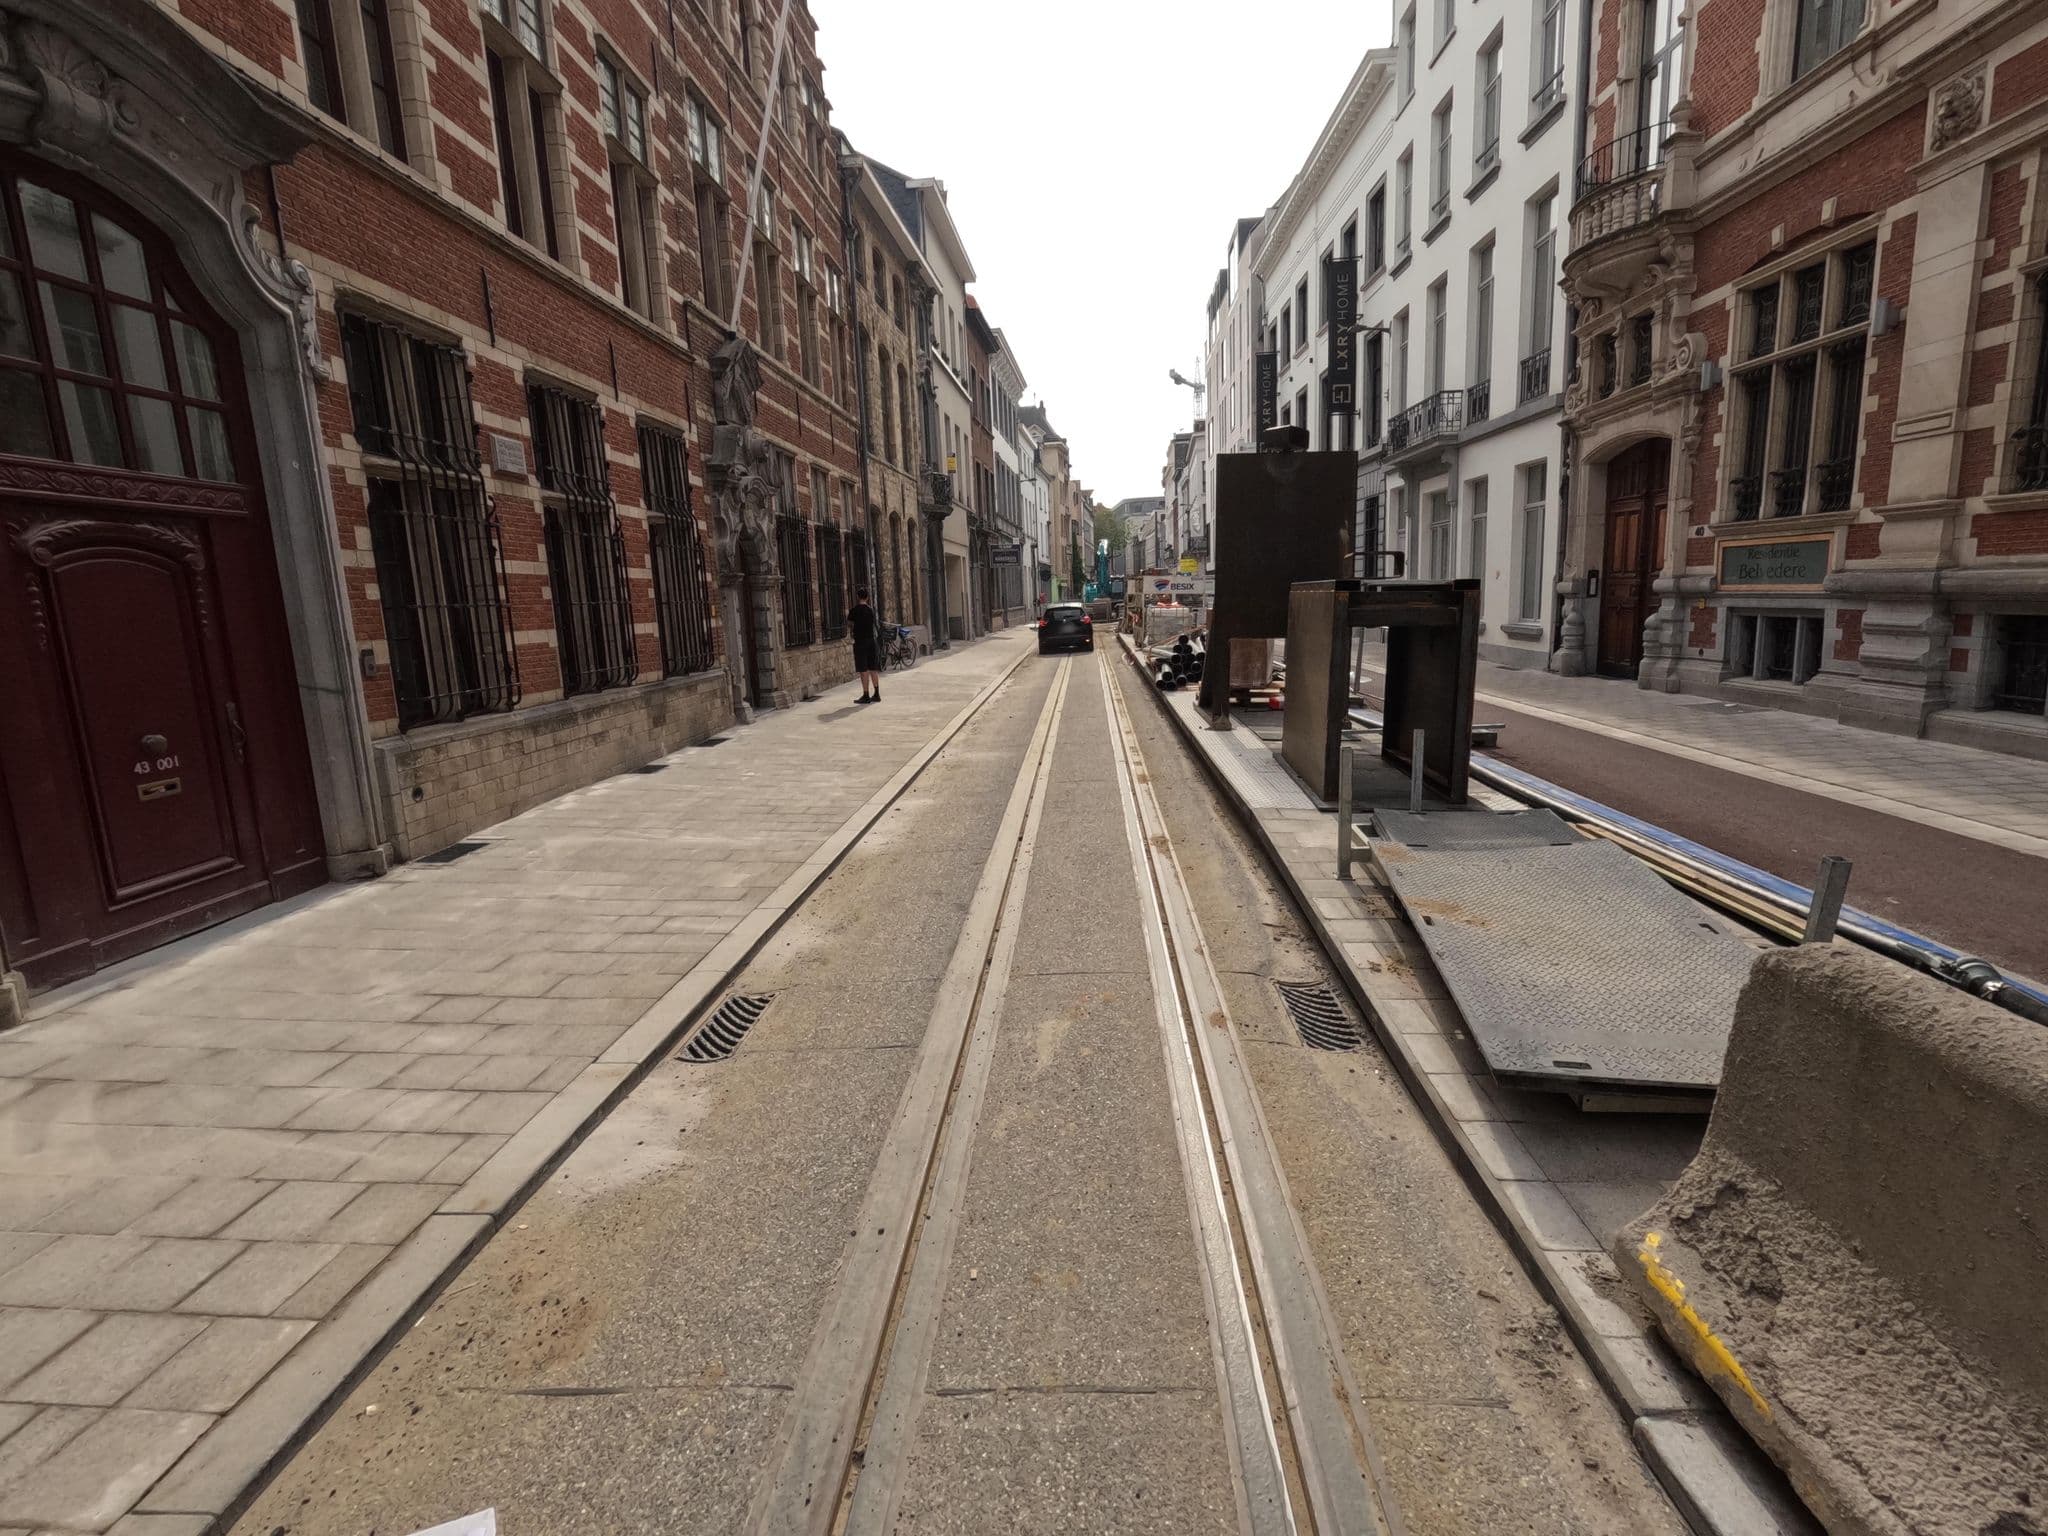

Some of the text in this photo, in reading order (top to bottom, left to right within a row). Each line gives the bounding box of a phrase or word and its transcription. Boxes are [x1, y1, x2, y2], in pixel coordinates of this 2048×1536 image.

[1262, 363, 1271, 427] XRYHOME
[1694, 525, 1705, 537] 40
[1170, 582, 1194, 591] BESIX
[134, 755, 180, 775] 43 001
